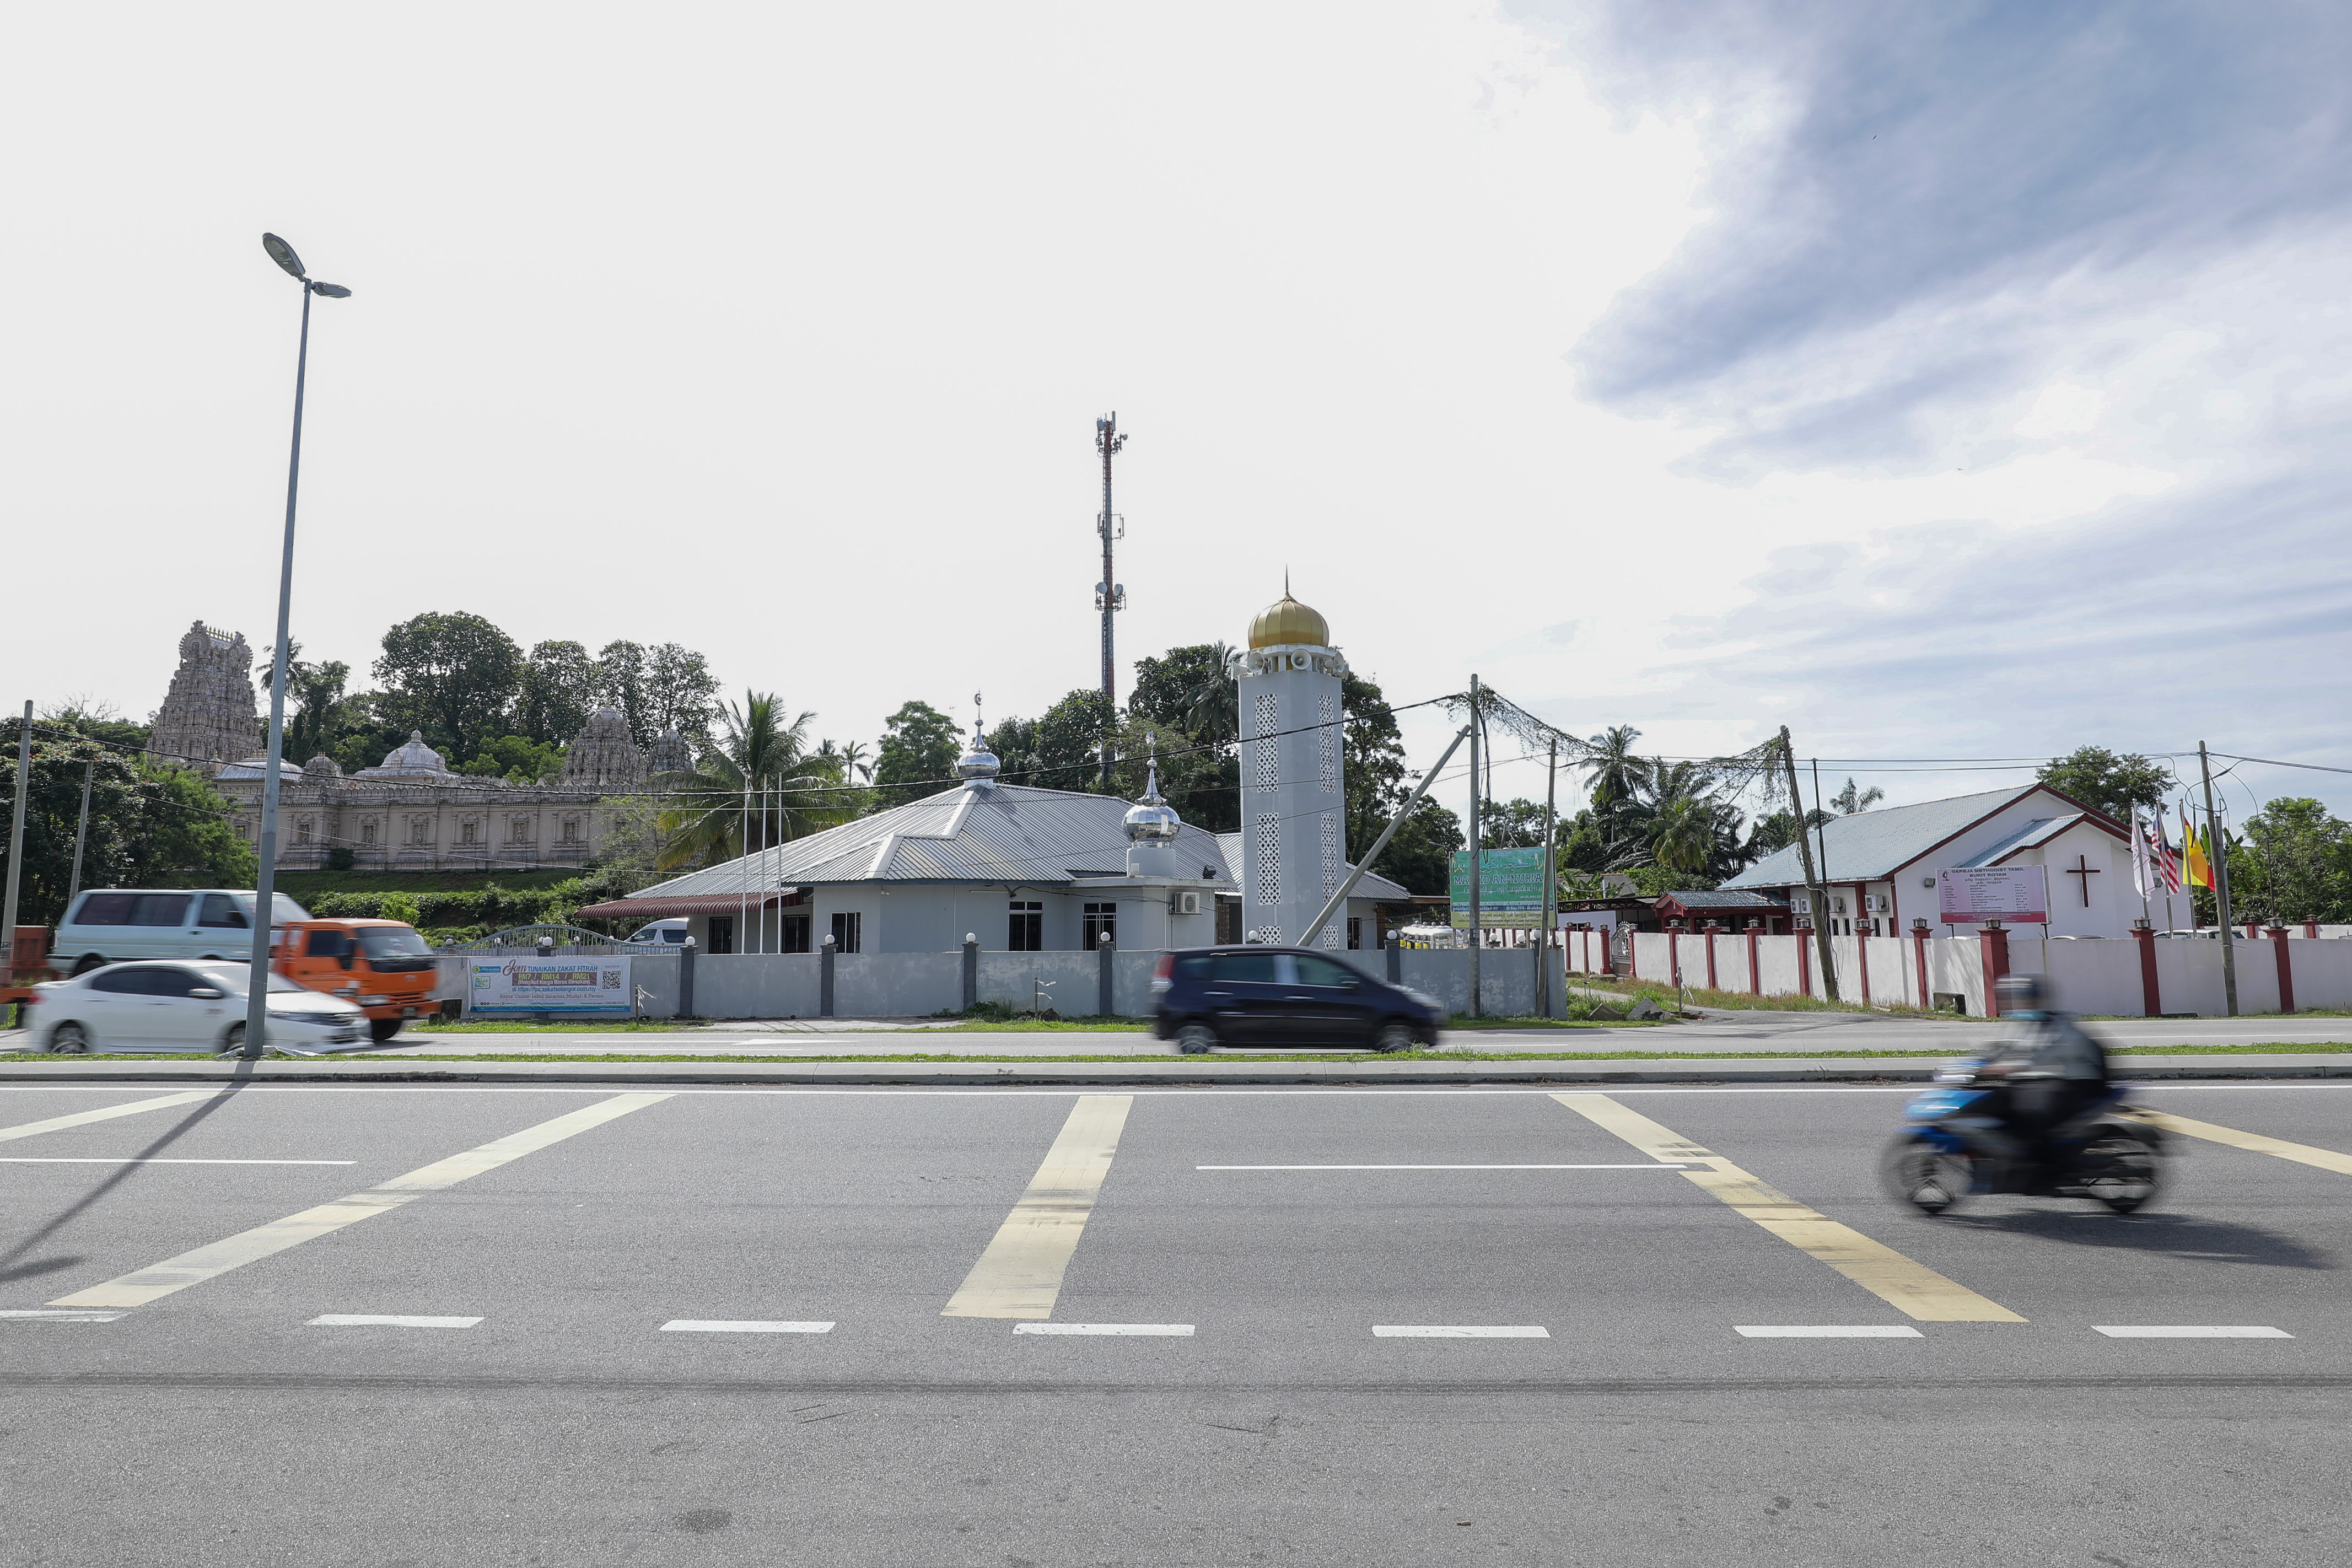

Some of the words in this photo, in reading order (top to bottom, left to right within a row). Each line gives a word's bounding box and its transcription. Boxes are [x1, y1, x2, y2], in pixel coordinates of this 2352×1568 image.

[1454, 875, 1490, 885] MAID
[1492, 874, 1544, 884] AN-NURIA
[502, 959, 527, 977] Jom
